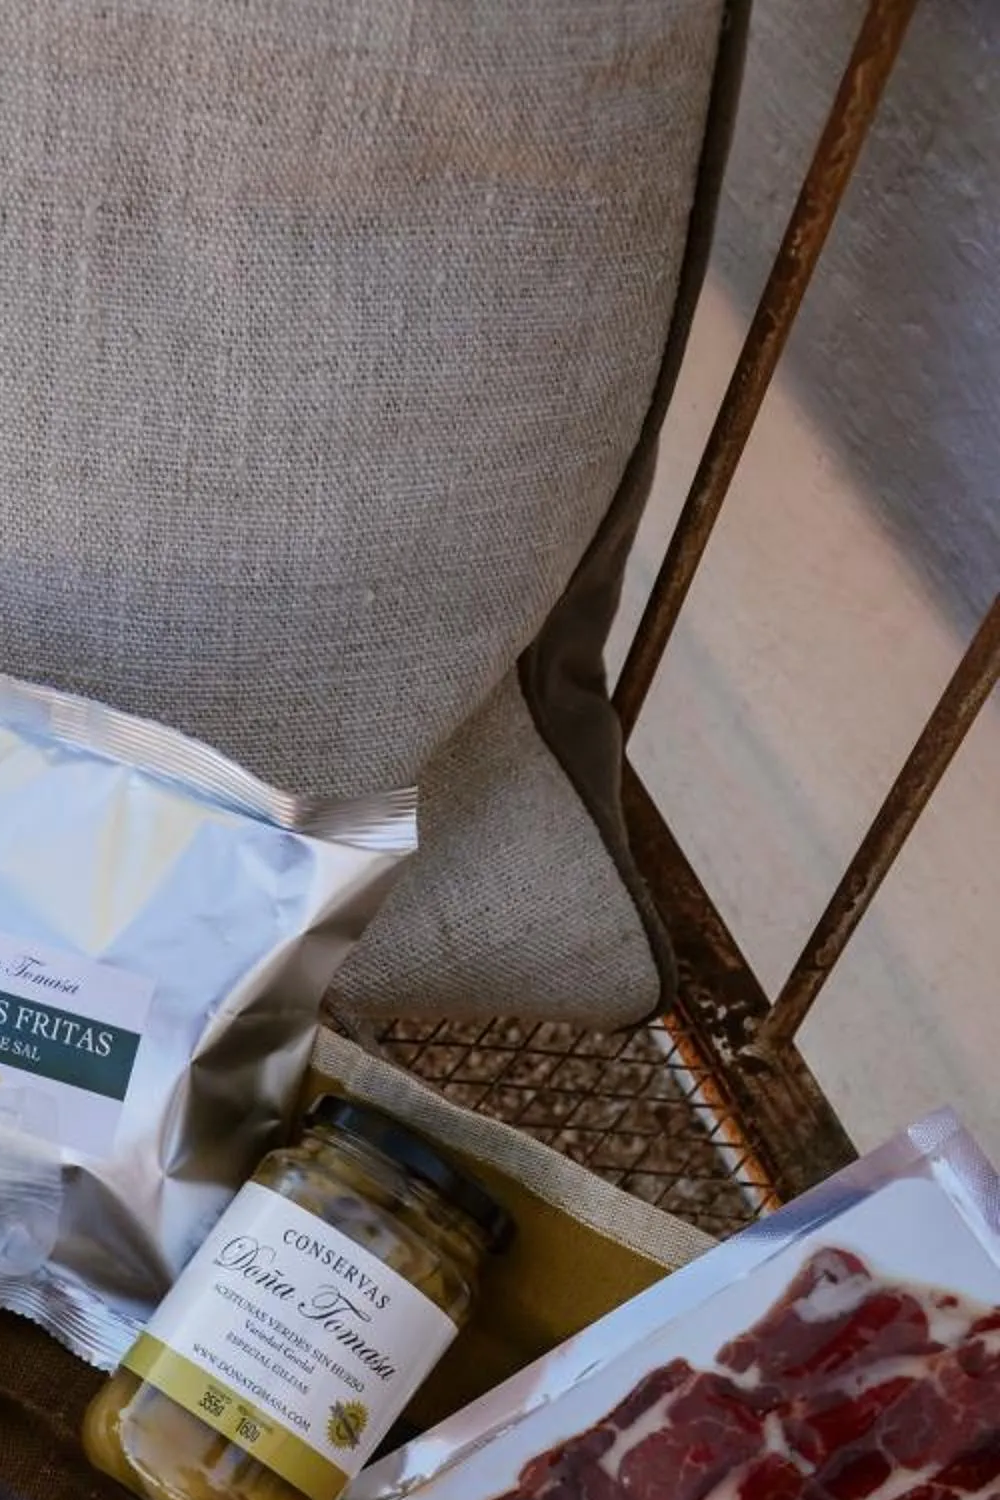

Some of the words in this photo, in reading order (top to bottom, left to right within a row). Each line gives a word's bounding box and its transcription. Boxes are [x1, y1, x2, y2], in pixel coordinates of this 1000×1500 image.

[5, 956, 79, 994] Tomasa
[11, 1039, 40, 1062] SAL
[14, 1006, 113, 1056] FRITAS
[282, 1228, 390, 1309] CONSERVAS
[213, 1235, 295, 1300] Doña
[297, 1285, 395, 1380] Tomasa
[268, 1316, 312, 1352] VERDES
[310, 1348, 333, 1368] SIN
